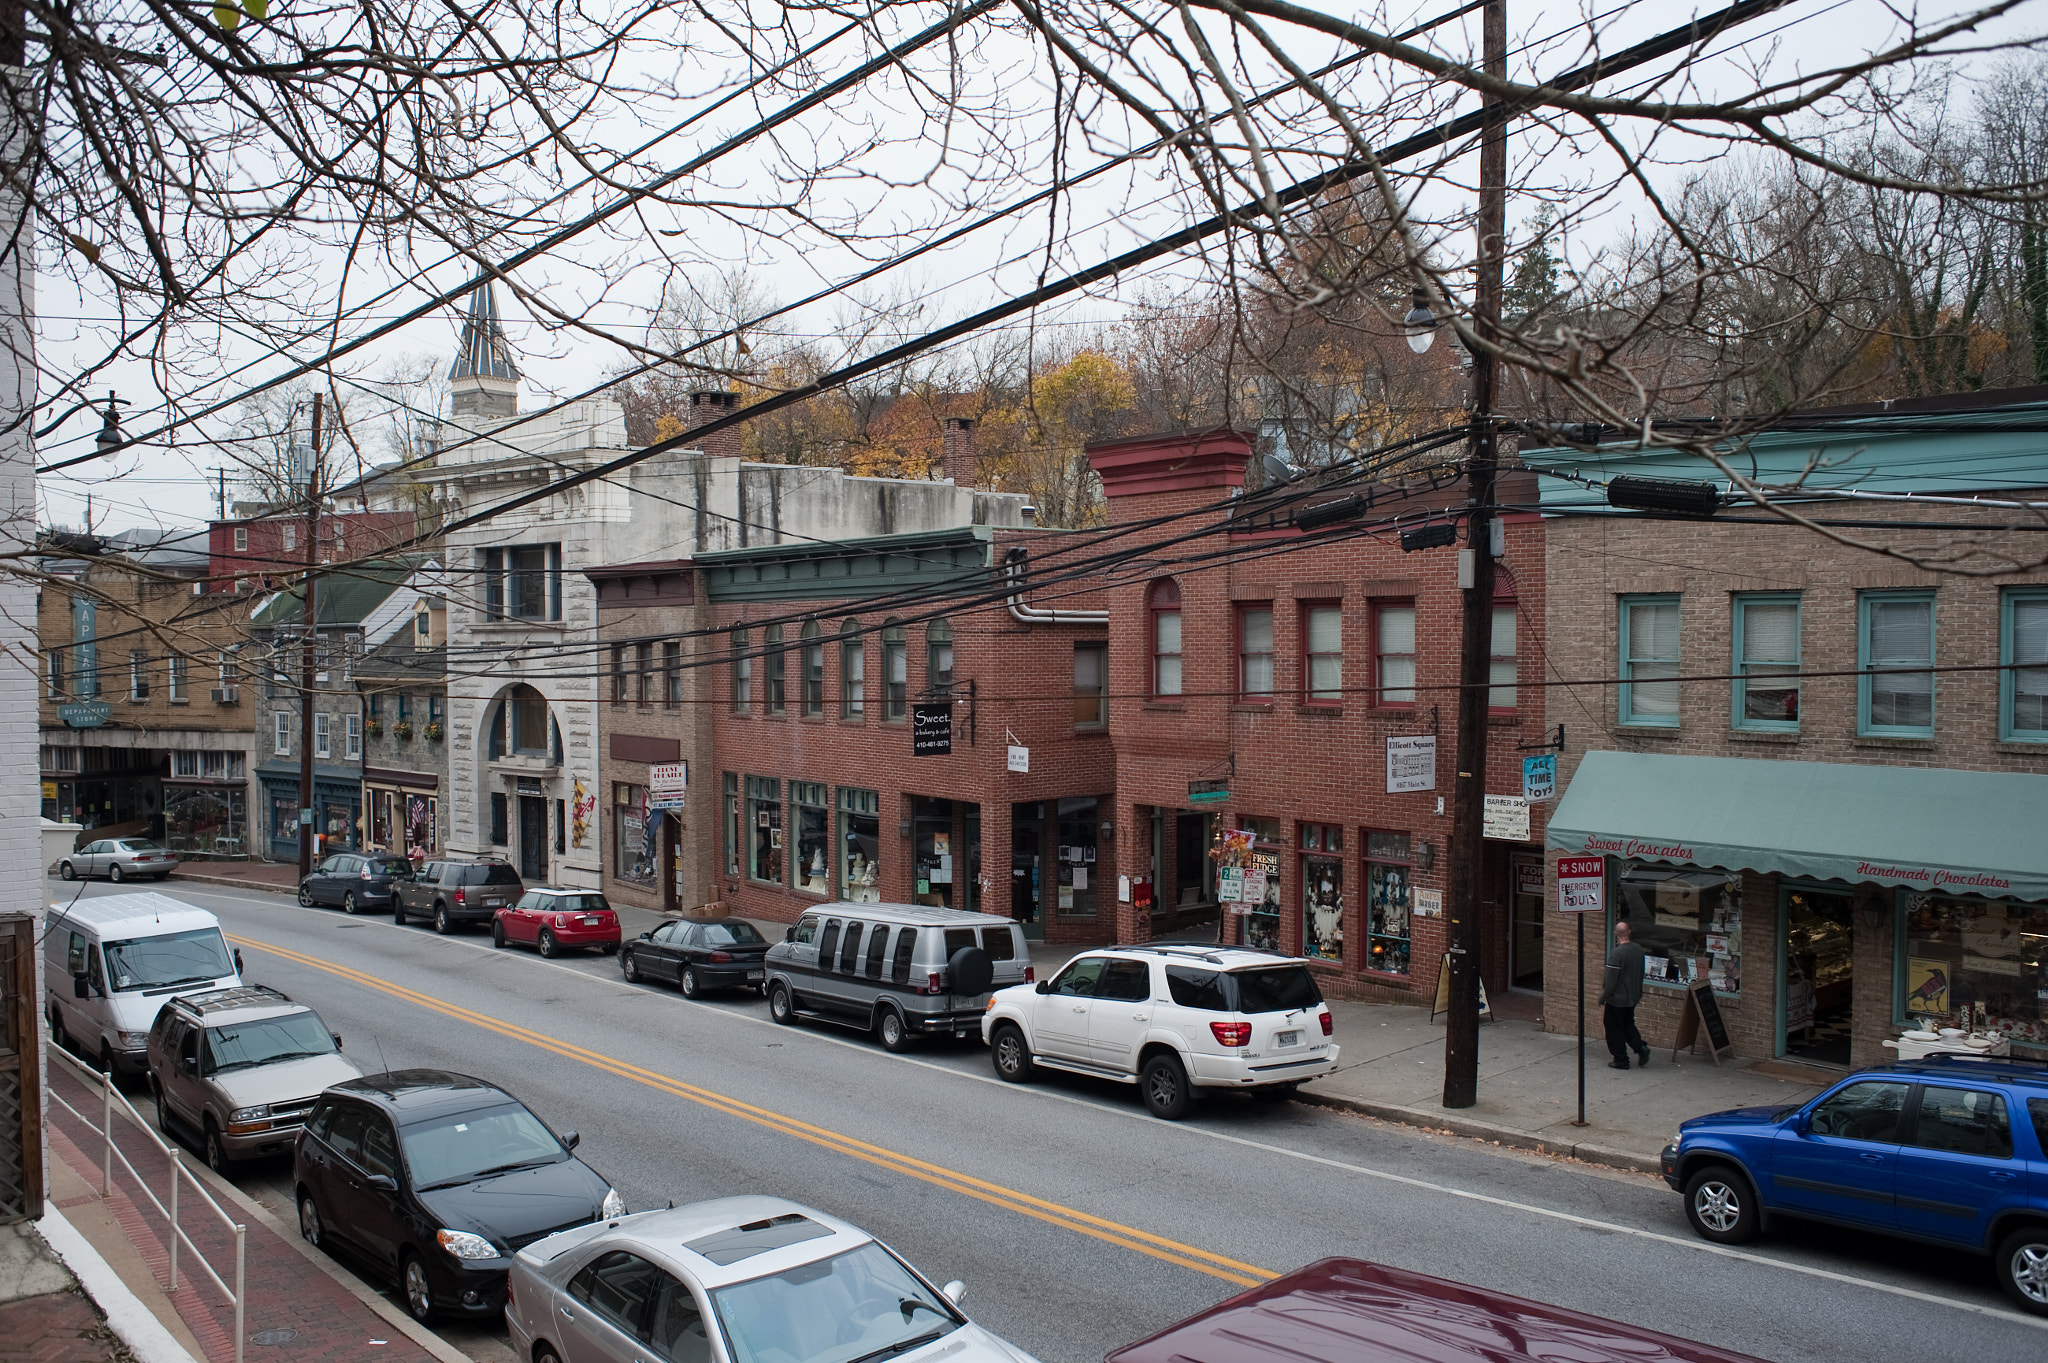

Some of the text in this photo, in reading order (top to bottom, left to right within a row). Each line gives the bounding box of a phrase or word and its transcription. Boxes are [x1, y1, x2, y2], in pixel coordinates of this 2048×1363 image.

[919, 728, 936, 737] bakery
[1388, 740, 1435, 750] Ellicott Square
[1531, 761, 1549, 773] ALL
[1529, 772, 1552, 785] TIME
[1528, 784, 1553, 798] TOYS
[1584, 834, 1693, 859] Sweet Cascades
[1252, 853, 1277, 865] FRESH
[1223, 869, 1229, 879] 2
[1252, 862, 1278, 874] FUDGE
[1571, 862, 1601, 874] SNOW
[1856, 861, 2010, 889] Handmade Chocolates
[1561, 882, 1600, 893] EMERGENCY
